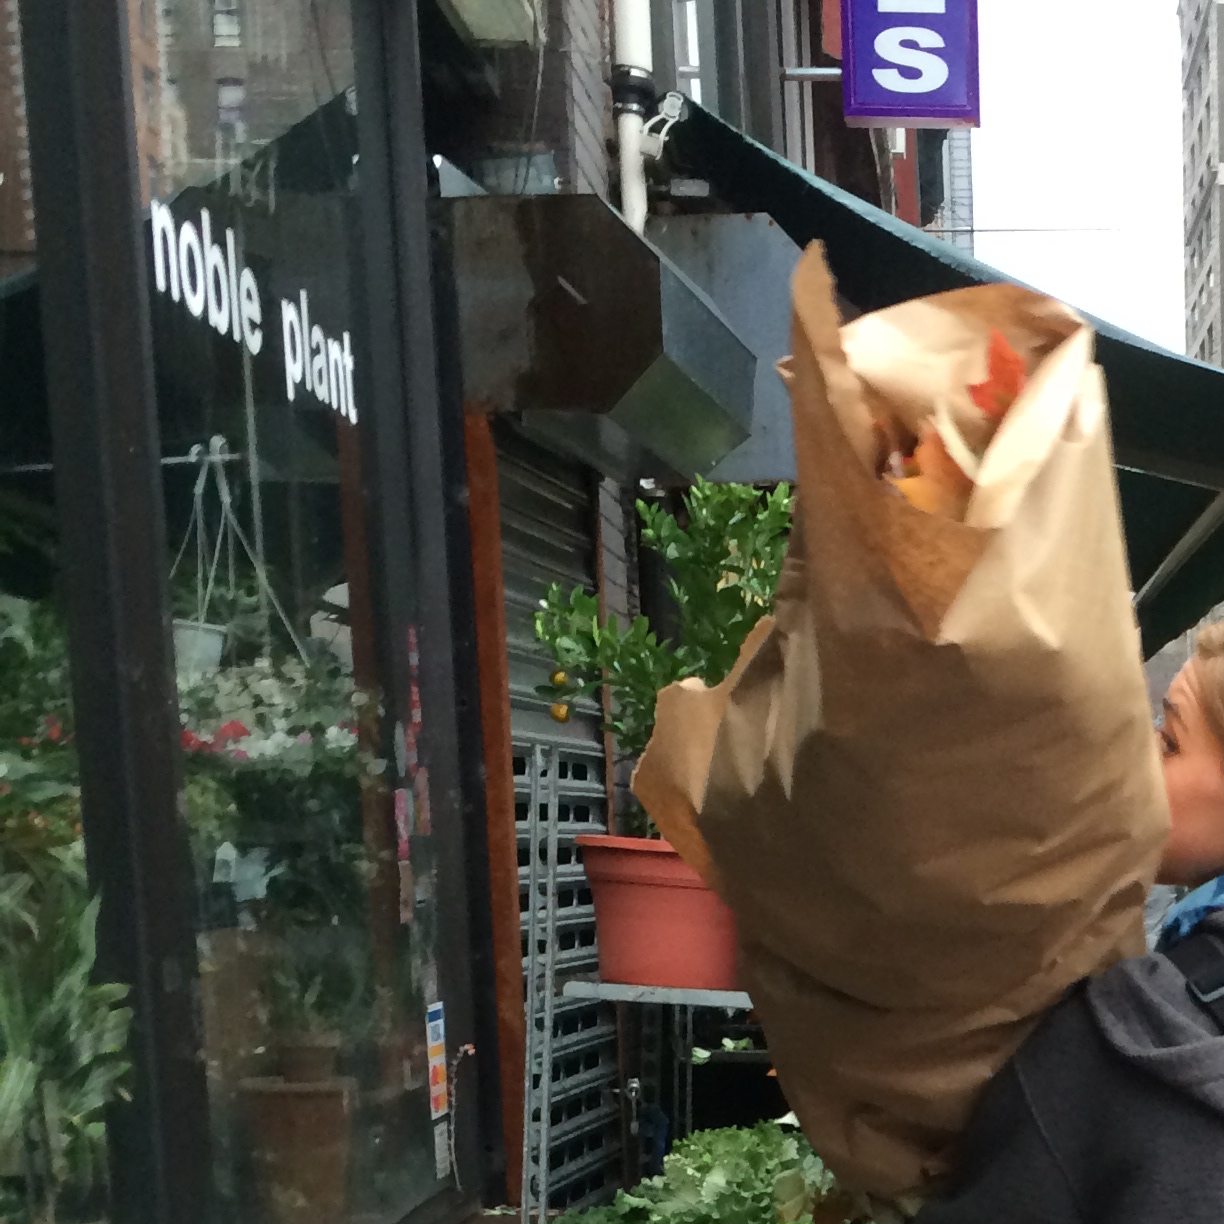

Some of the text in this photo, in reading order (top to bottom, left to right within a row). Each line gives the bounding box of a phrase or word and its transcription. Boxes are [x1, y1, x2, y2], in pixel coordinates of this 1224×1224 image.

[871, 0, 949, 93] S
[151, 199, 358, 425] noble plant
